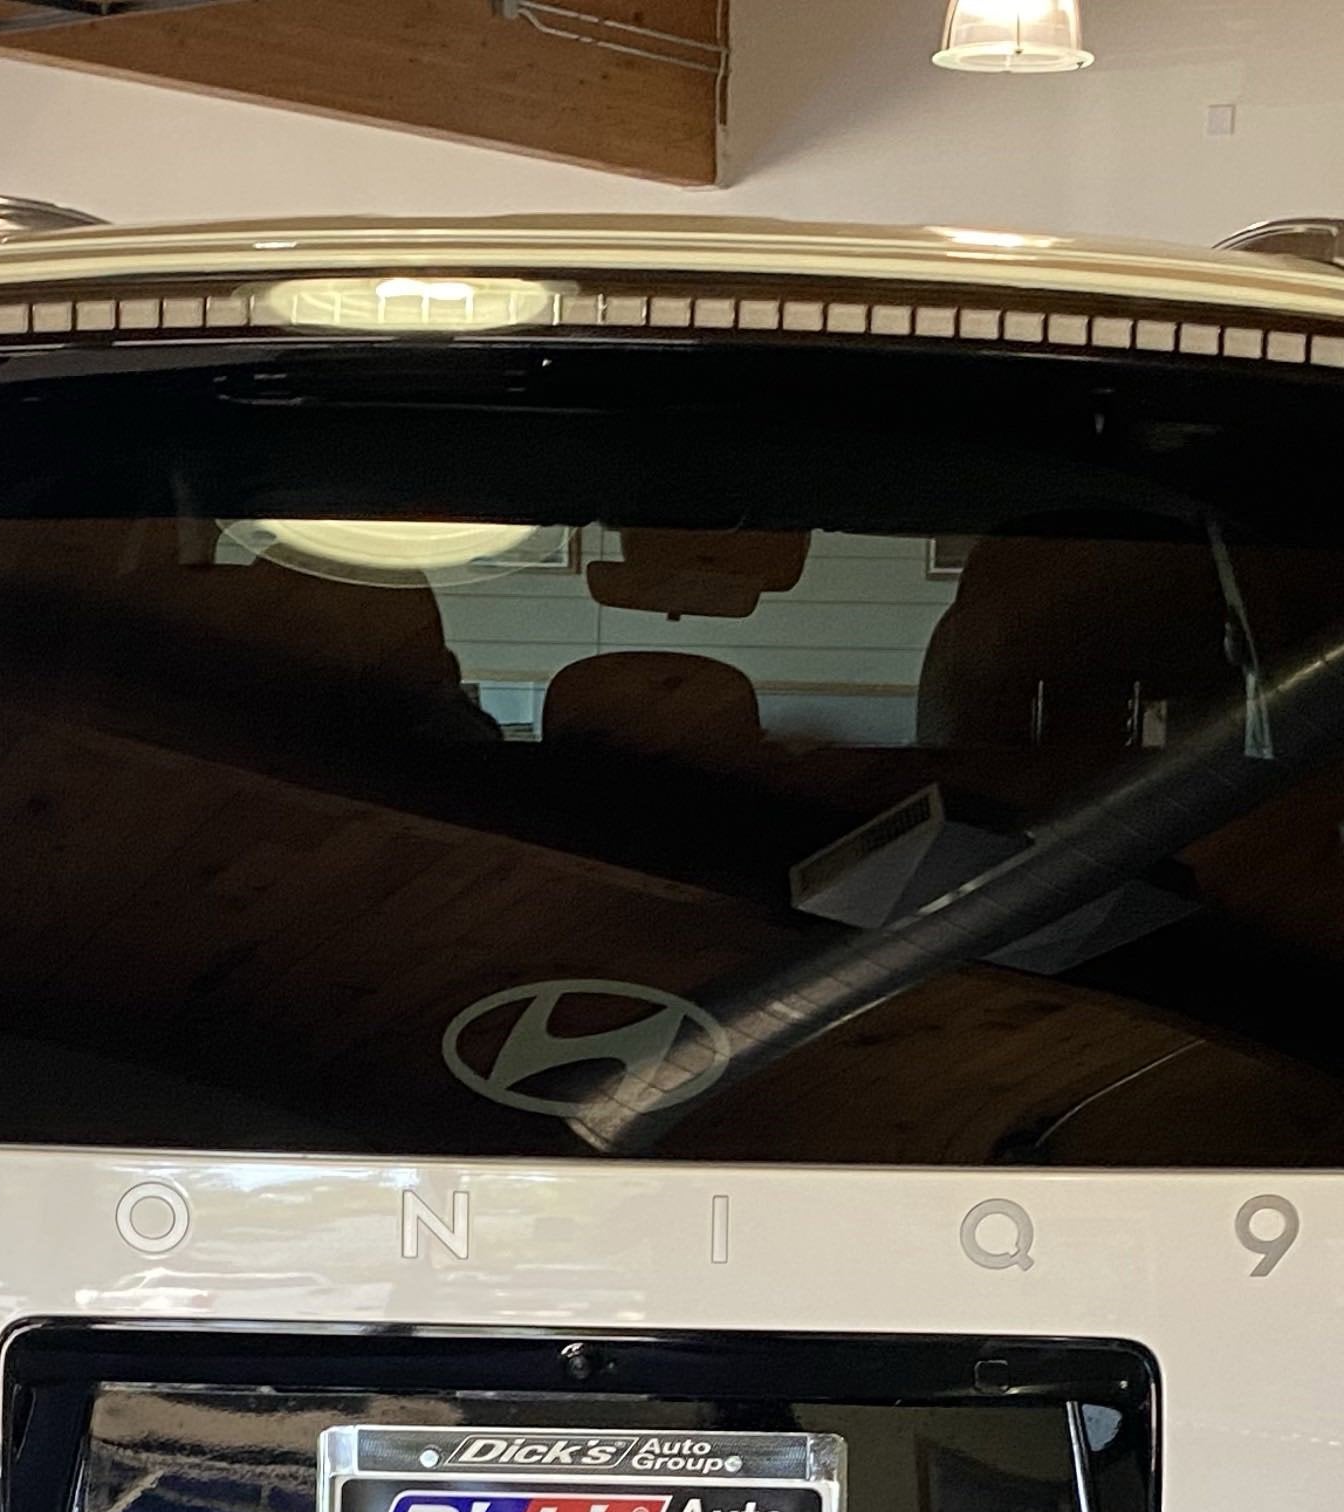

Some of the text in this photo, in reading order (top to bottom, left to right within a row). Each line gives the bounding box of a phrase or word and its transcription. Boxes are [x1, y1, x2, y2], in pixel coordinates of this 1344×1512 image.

[1234, 1193, 1300, 1277] 9
[458, 1437, 712, 1465] Dick's Auto
[631, 1453, 724, 1474] Group
